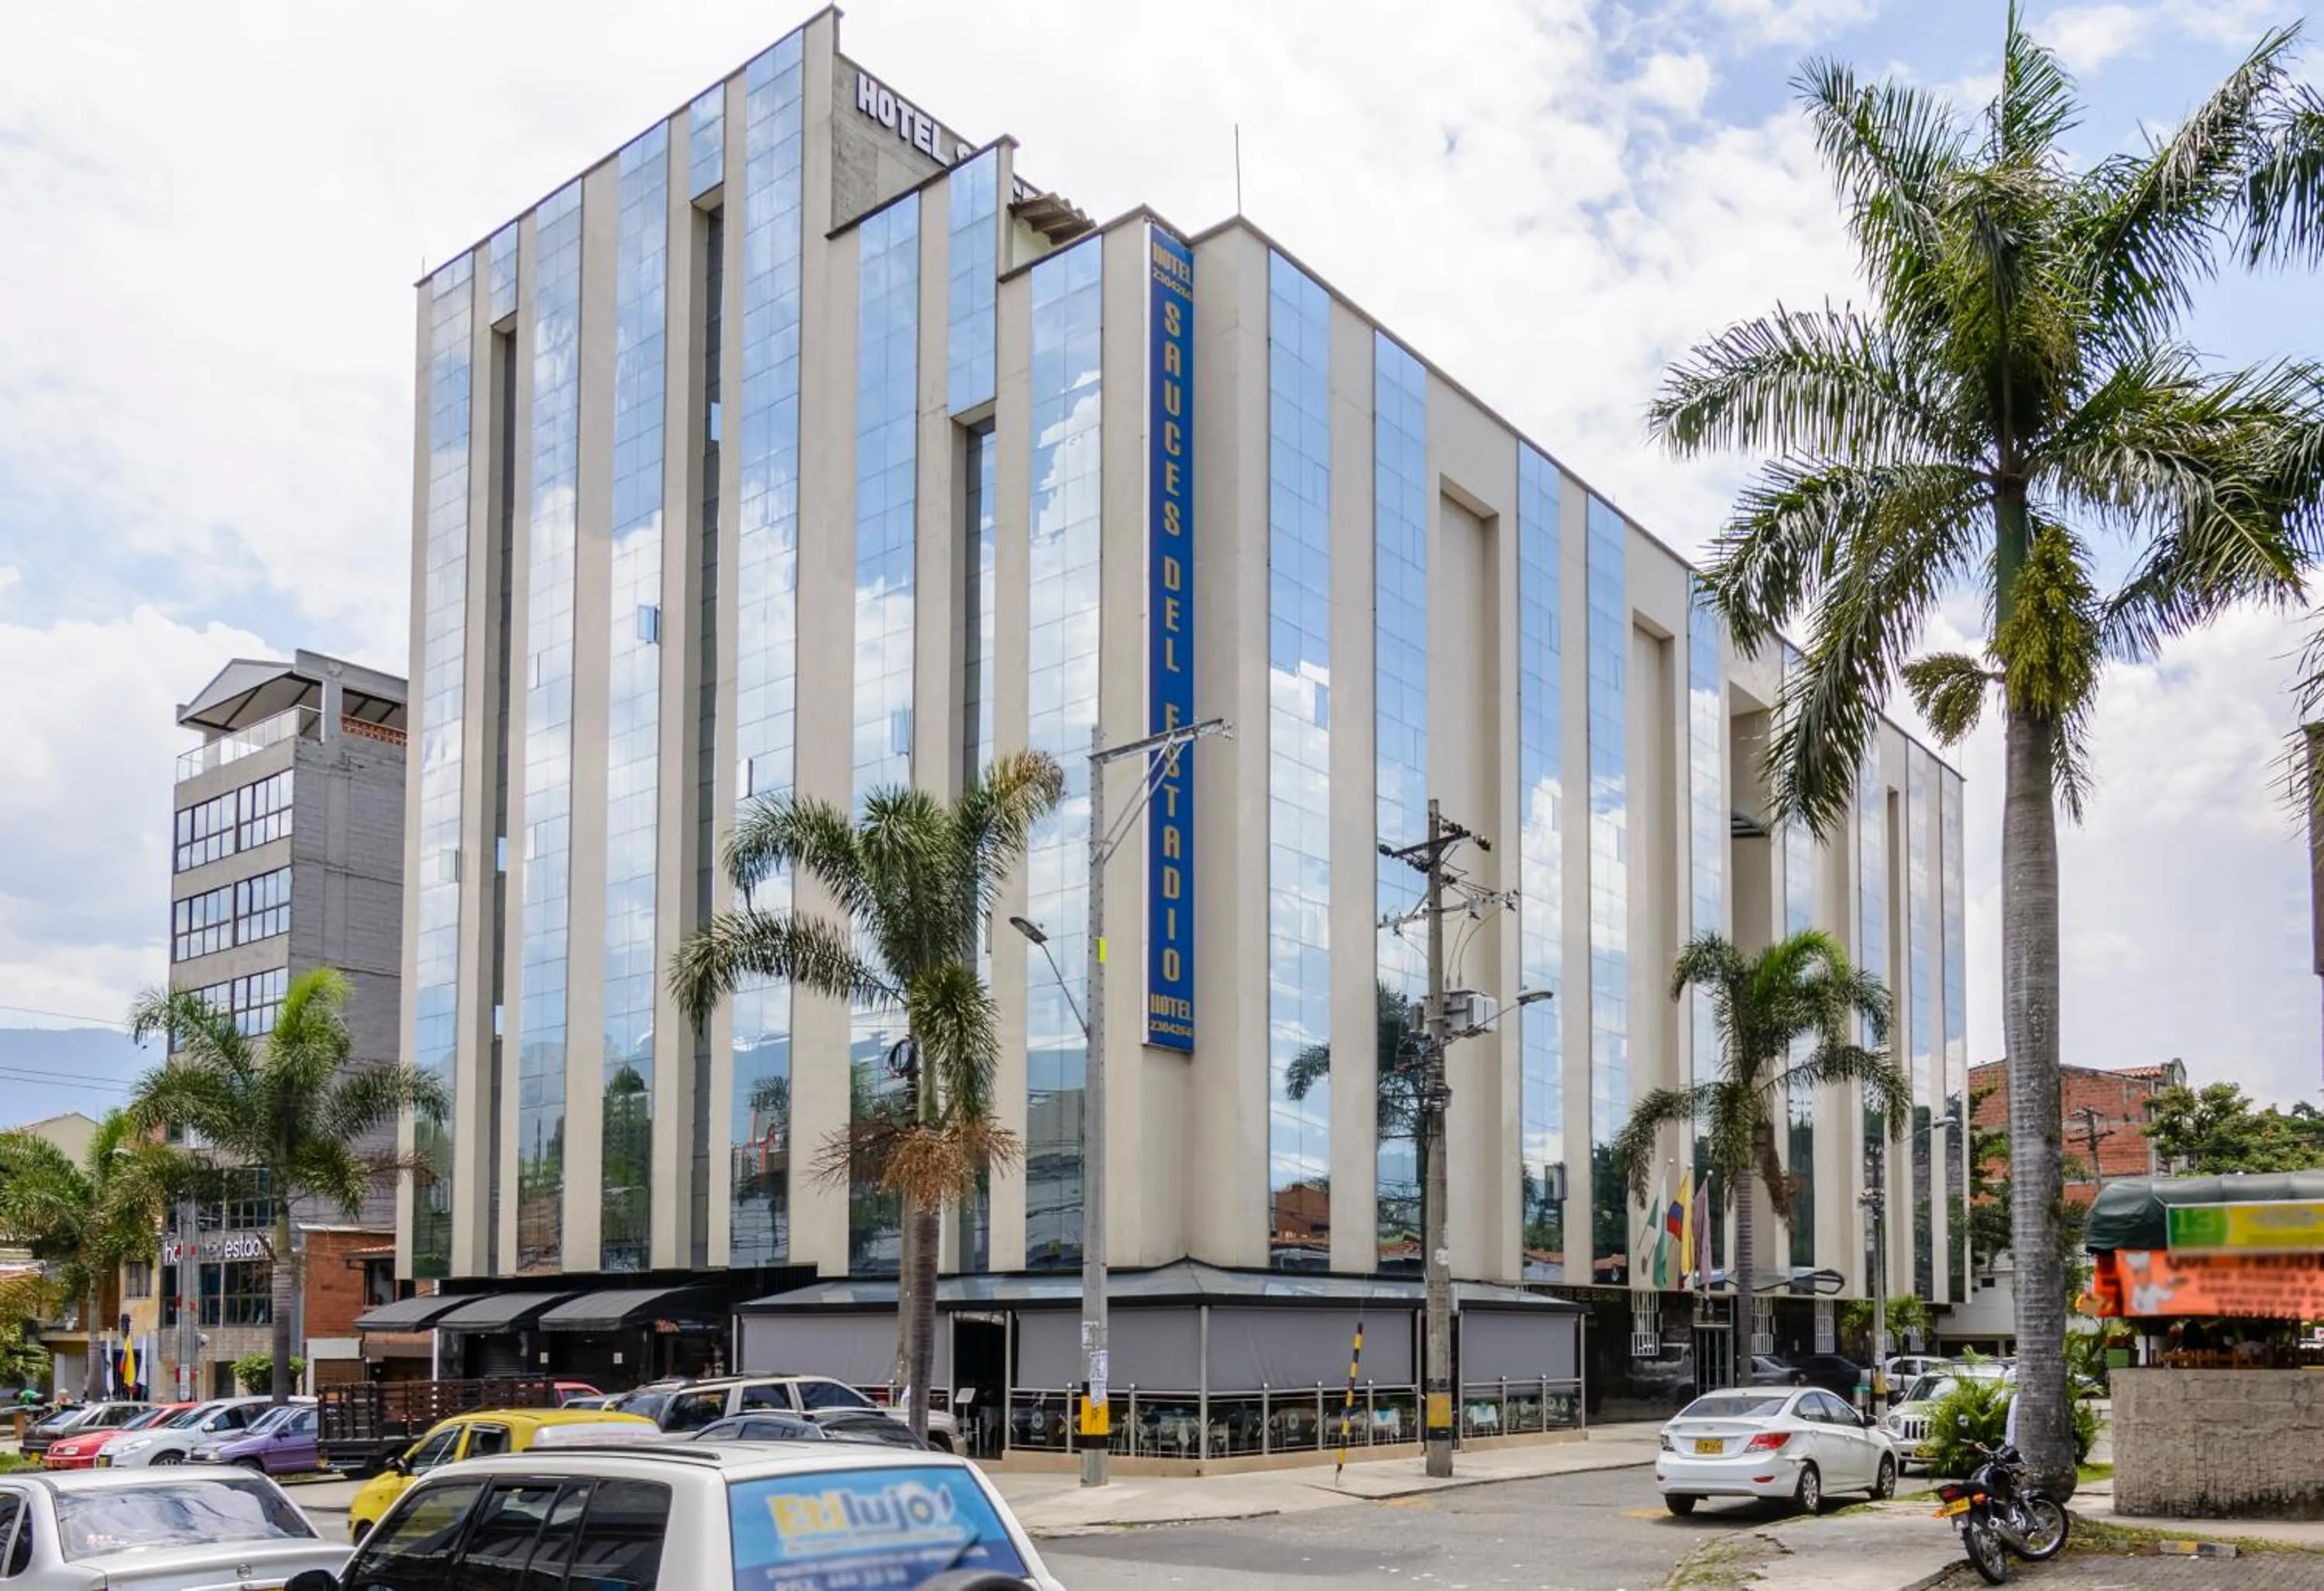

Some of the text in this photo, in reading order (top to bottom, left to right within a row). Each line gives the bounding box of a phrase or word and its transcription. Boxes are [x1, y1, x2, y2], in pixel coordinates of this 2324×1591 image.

[856, 72, 950, 168] HOTEL
[1151, 242, 1191, 285] HOTEL
[1164, 301, 1181, 981] SAUCES DEL ESTADIO
[1150, 994, 1192, 1021] HOTEL
